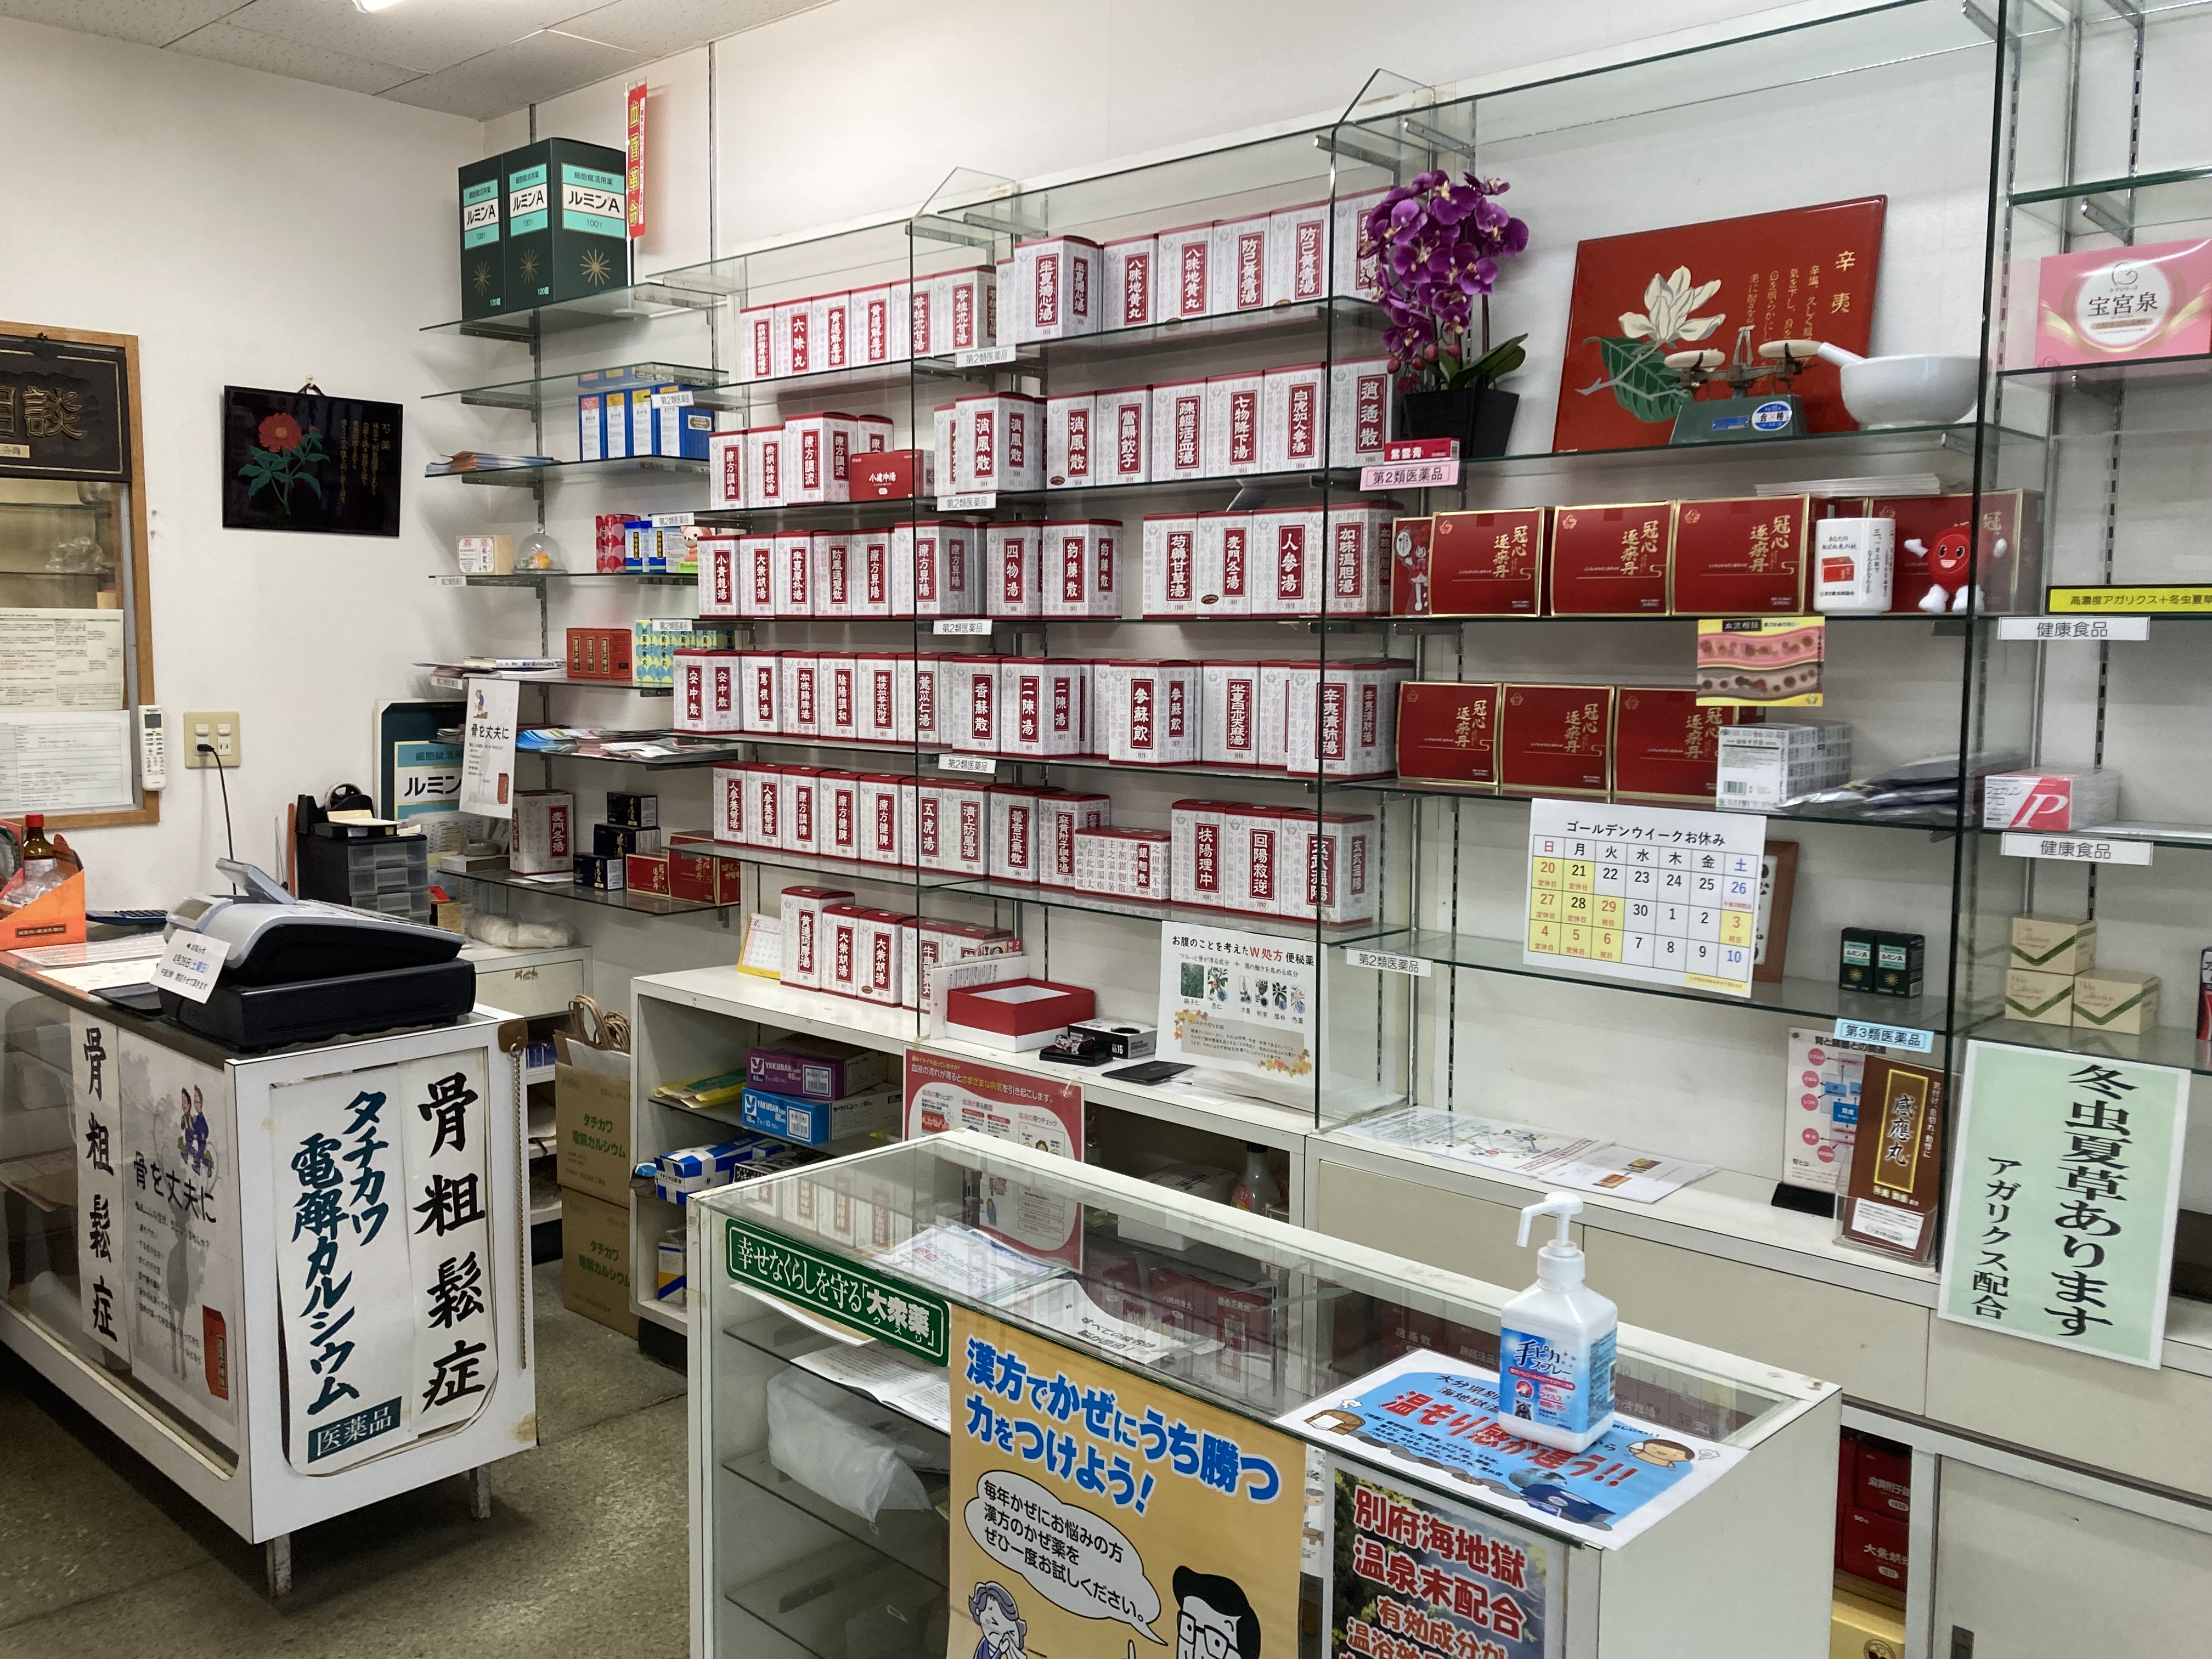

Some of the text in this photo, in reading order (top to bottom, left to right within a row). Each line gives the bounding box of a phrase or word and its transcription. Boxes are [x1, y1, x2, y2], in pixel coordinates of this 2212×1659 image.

[574, 172, 613, 185] 細胞賦活用薬
[1128, 258, 1143, 320] 八味地黄丸
[1185, 247, 1201, 310] 八味地黄丸
[1831, 251, 1855, 314] 辛夷
[2088, 291, 2159, 317] 宝宮泉
[794, 319, 804, 368] 六味丸
[966, 351, 1008, 364] 第2類医薬品
[661, 393, 689, 405] 第2類医薬品
[976, 418, 991, 471] 消風散
[1011, 418, 1022, 462] 消風散
[1069, 416, 1085, 470] 消風散
[1234, 396, 1250, 459] 七物降下湯
[765, 445, 775, 494] 柴胡桂枝湯
[1373, 469, 1442, 484] 第2類医薬品
[659, 516, 689, 526] 第2類医薬品
[947, 498, 987, 509] 第2類医薬品
[1512, 525, 1528, 558] 冠心
[1640, 521, 1660, 554] 冠心
[1770, 515, 1791, 550] 冠心
[757, 555, 766, 599] 大柴胡湯
[792, 551, 803, 601] 半夏厚朴湯
[832, 550, 843, 600] 防風通聖散
[1006, 545, 1019, 597] 四物湯
[660, 621, 689, 630] 第2類医薬品
[943, 623, 983, 633] 第2類医薬品
[2036, 622, 2108, 637] 健康食品
[689, 670, 699, 716] 安中散
[718, 670, 728, 708] 安中散
[759, 671, 769, 718] 葛根湯
[838, 674, 847, 721] 陰陽調和
[918, 675, 930, 727] 薏苡仁湯
[974, 682, 989, 731] 香蘇散
[1022, 682, 1035, 736] 二陳湯
[1055, 682, 1066, 726] 二陳湯
[471, 724, 509, 741] 骨を丈夫に
[1322, 689, 1340, 754] 辛夷清肺湯
[948, 759, 987, 771] 第2類医薬品
[949, 759, 987, 771] 第2類医薬品
[923, 804, 935, 851] 五虎湯
[963, 805, 975, 857] 清上防風湯
[2016, 793, 2068, 828] P
[1058, 815, 1069, 873] 麻黄附子細辛湯
[1567, 821, 1725, 847] ゴールデンウイークお休み
[2040, 840, 2111, 859] 健康食品
[1198, 828, 1213, 887] 扶陽理中
[1253, 834, 1268, 895] 回陽救逆
[1352, 840, 1363, 890] 玄武温陽
[1541, 862, 1746, 894] 20 21 22 23 24 25 26
[1544, 841, 1748, 872] 日 月 火 水 木 金 土
[1538, 879, 1556, 888] 定休日
[1568, 883, 1588, 891] 定休日
[1536, 911, 1555, 919] 定休日
[1541, 894, 1741, 928] 27 28 29 30 1 2 3
[1567, 915, 1586, 923] 定休日
[1602, 918, 1615, 927] 祝日
[838, 932, 849, 978] 大柴胡湯
[1286, 952, 1314, 966] 便秘薬
[1534, 943, 1554, 951] 定休日
[1541, 926, 1741, 963] 4 5 6 7 8 9 10
[1566, 946, 1585, 955] 定休日
[1600, 951, 1613, 960] 祝日
[1729, 935, 1742, 944] 祝日
[876, 939, 886, 985] 大柴胡湯
[1359, 953, 1419, 973] 第2類医薬品
[1846, 1024, 1920, 1046] 第3類医薬品
[765, 1062, 792, 1072] YAKUBAN
[584, 1114, 613, 1133] タチカワ
[757, 1101, 778, 1112] YAKUBAN
[83, 1026, 118, 1343] 骨粗鬆症
[133, 1151, 217, 1224] 骨を丈夫に
[342, 1091, 389, 1246] タチカワ
[2044, 1064, 2138, 1336] 冬虫夏草あります
[413, 1072, 487, 1415] 骨粗鬆症
[590, 1240, 619, 1261] タチカワ
[1972, 1156, 2022, 1320] アガリクス配合
[291, 1132, 359, 1416] 電解カルシウム
[1533, 1361, 1571, 1375] スプレー
[317, 1404, 392, 1459] 医薬品
[966, 1336, 1280, 1503] 漢方でかぜにうち勝つ
[983, 1481, 1124, 1564] 毎年かぜにお悩みの方
[983, 1502, 1080, 1566] 漢方のかぜ薬を
[1355, 1487, 1526, 1589] 別府海地獄
[983, 1527, 1146, 1624] ぜひ一度お試しください。
[1355, 1536, 1525, 1641] 温泉末配合
